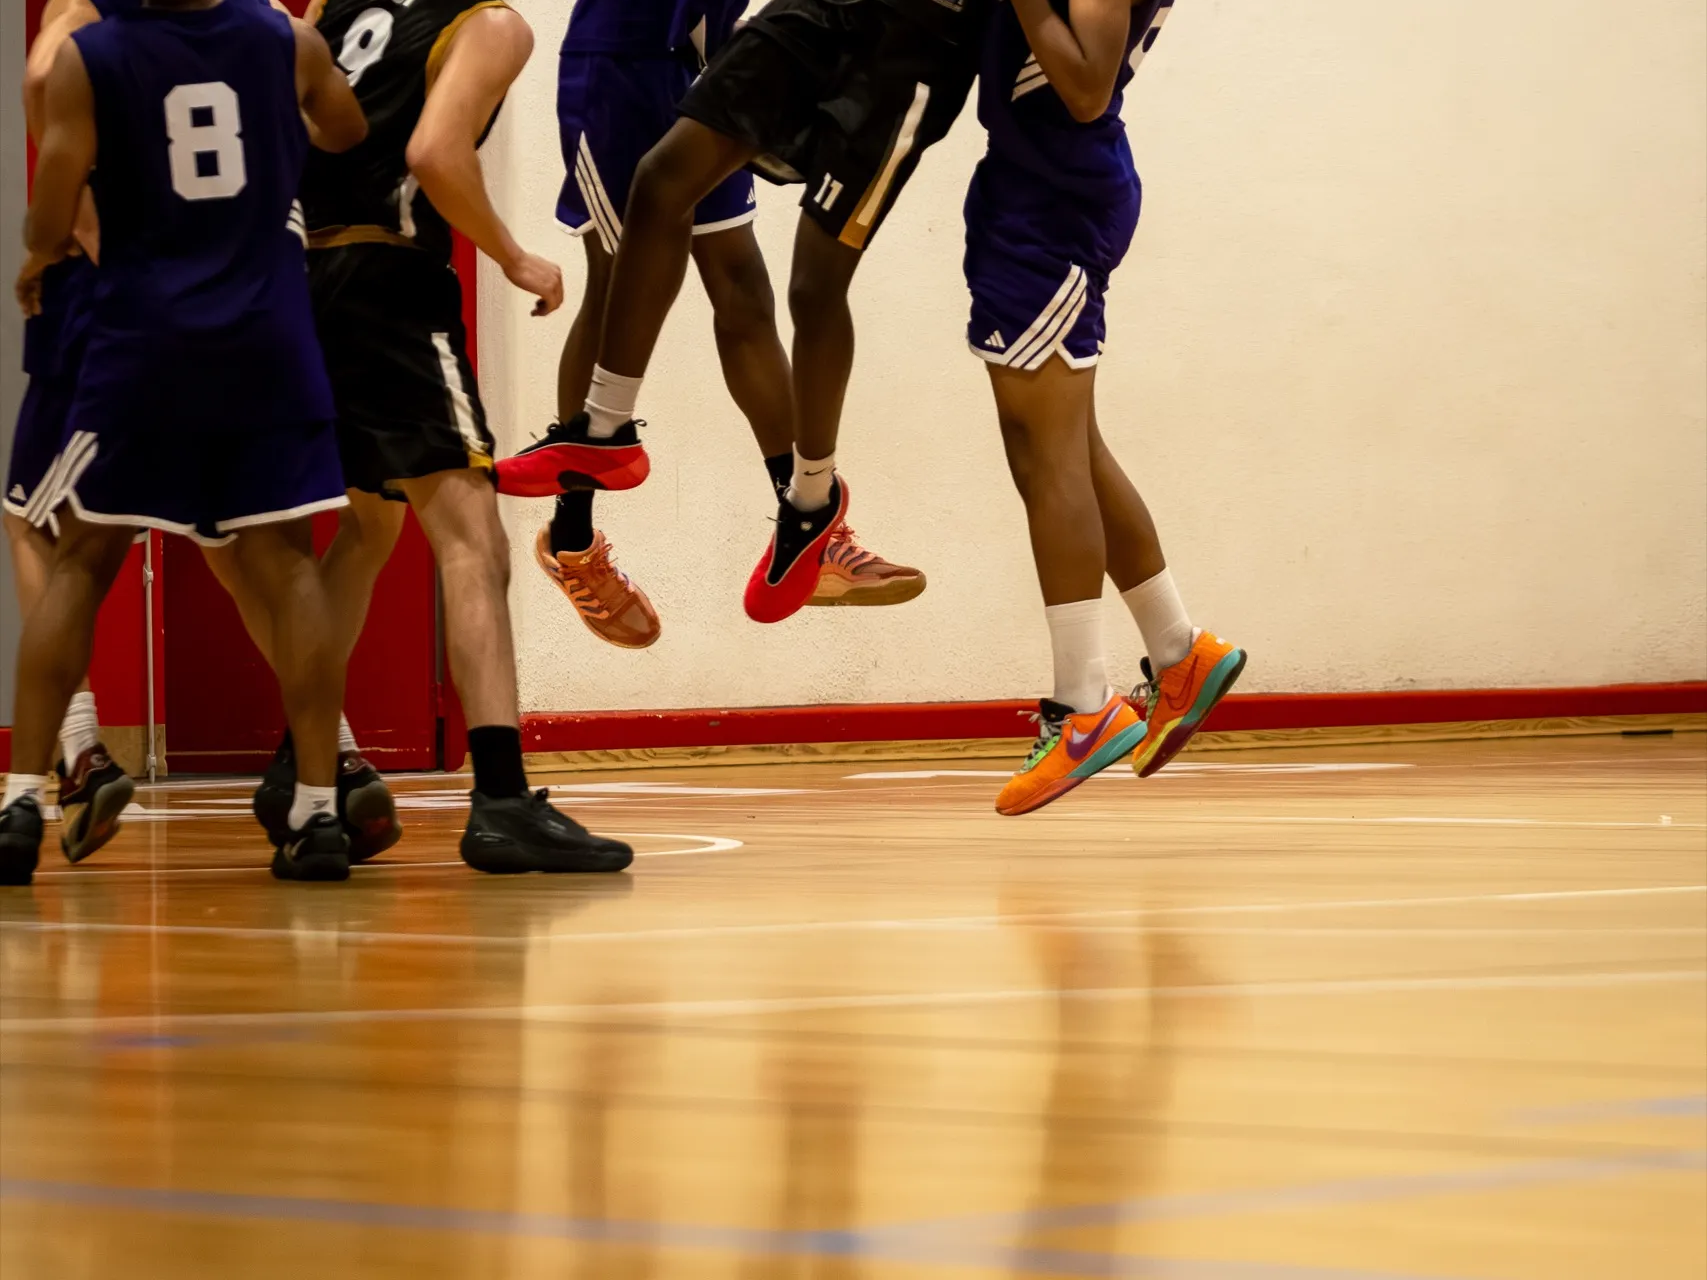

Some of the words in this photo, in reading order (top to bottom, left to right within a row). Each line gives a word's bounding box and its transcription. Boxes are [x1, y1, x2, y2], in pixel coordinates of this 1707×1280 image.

[338, 7, 394, 88] 9
[164, 81, 248, 201] 8
[813, 172, 844, 212] 11
